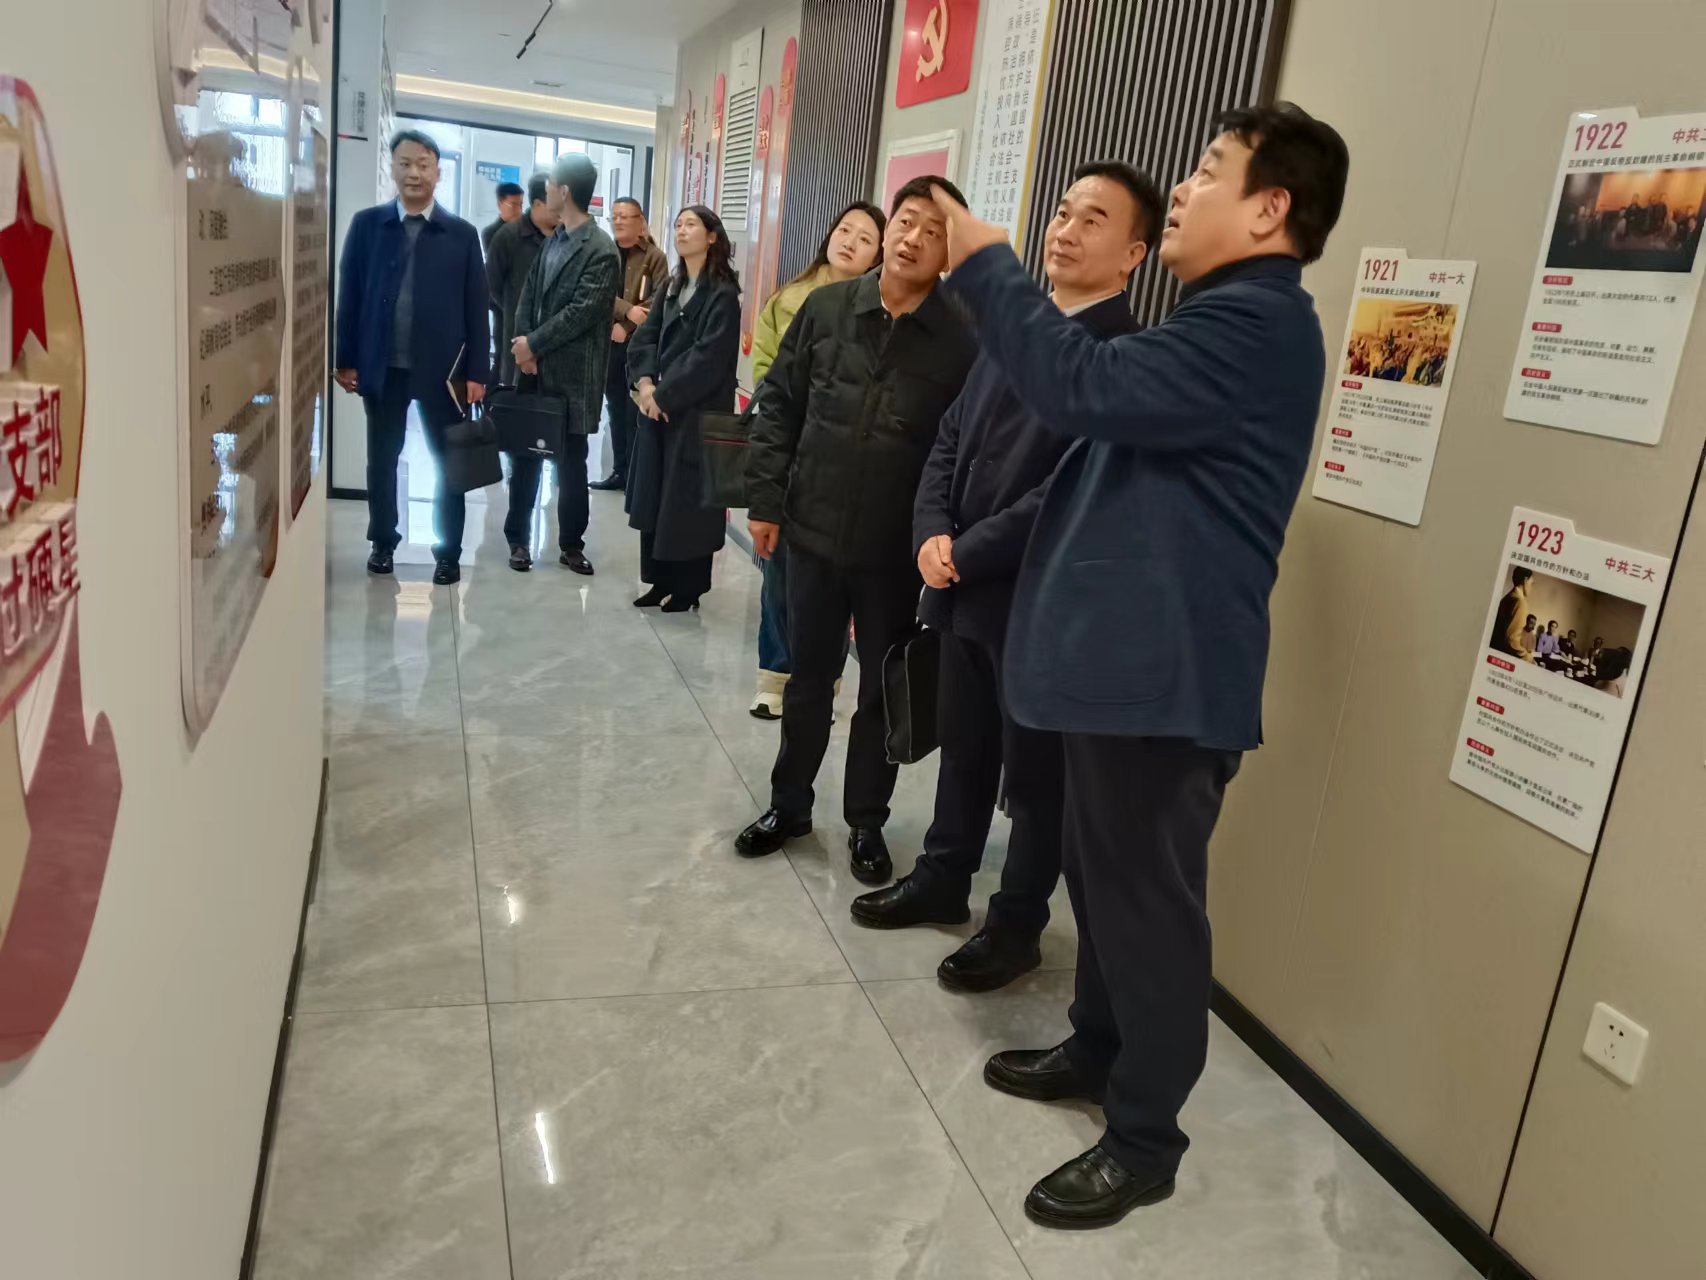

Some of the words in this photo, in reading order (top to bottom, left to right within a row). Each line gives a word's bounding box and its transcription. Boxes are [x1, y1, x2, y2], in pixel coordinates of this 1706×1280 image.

[1574, 121, 1628, 152] 1922
[1364, 258, 1399, 281] 1921
[1428, 271, 1467, 285] 中共一大
[3, 386, 62, 522] 支部
[1516, 521, 1565, 555] 1923
[1510, 551, 1590, 581] 决定国共合作的方针和办法
[1604, 557, 1657, 583] 中共三大
